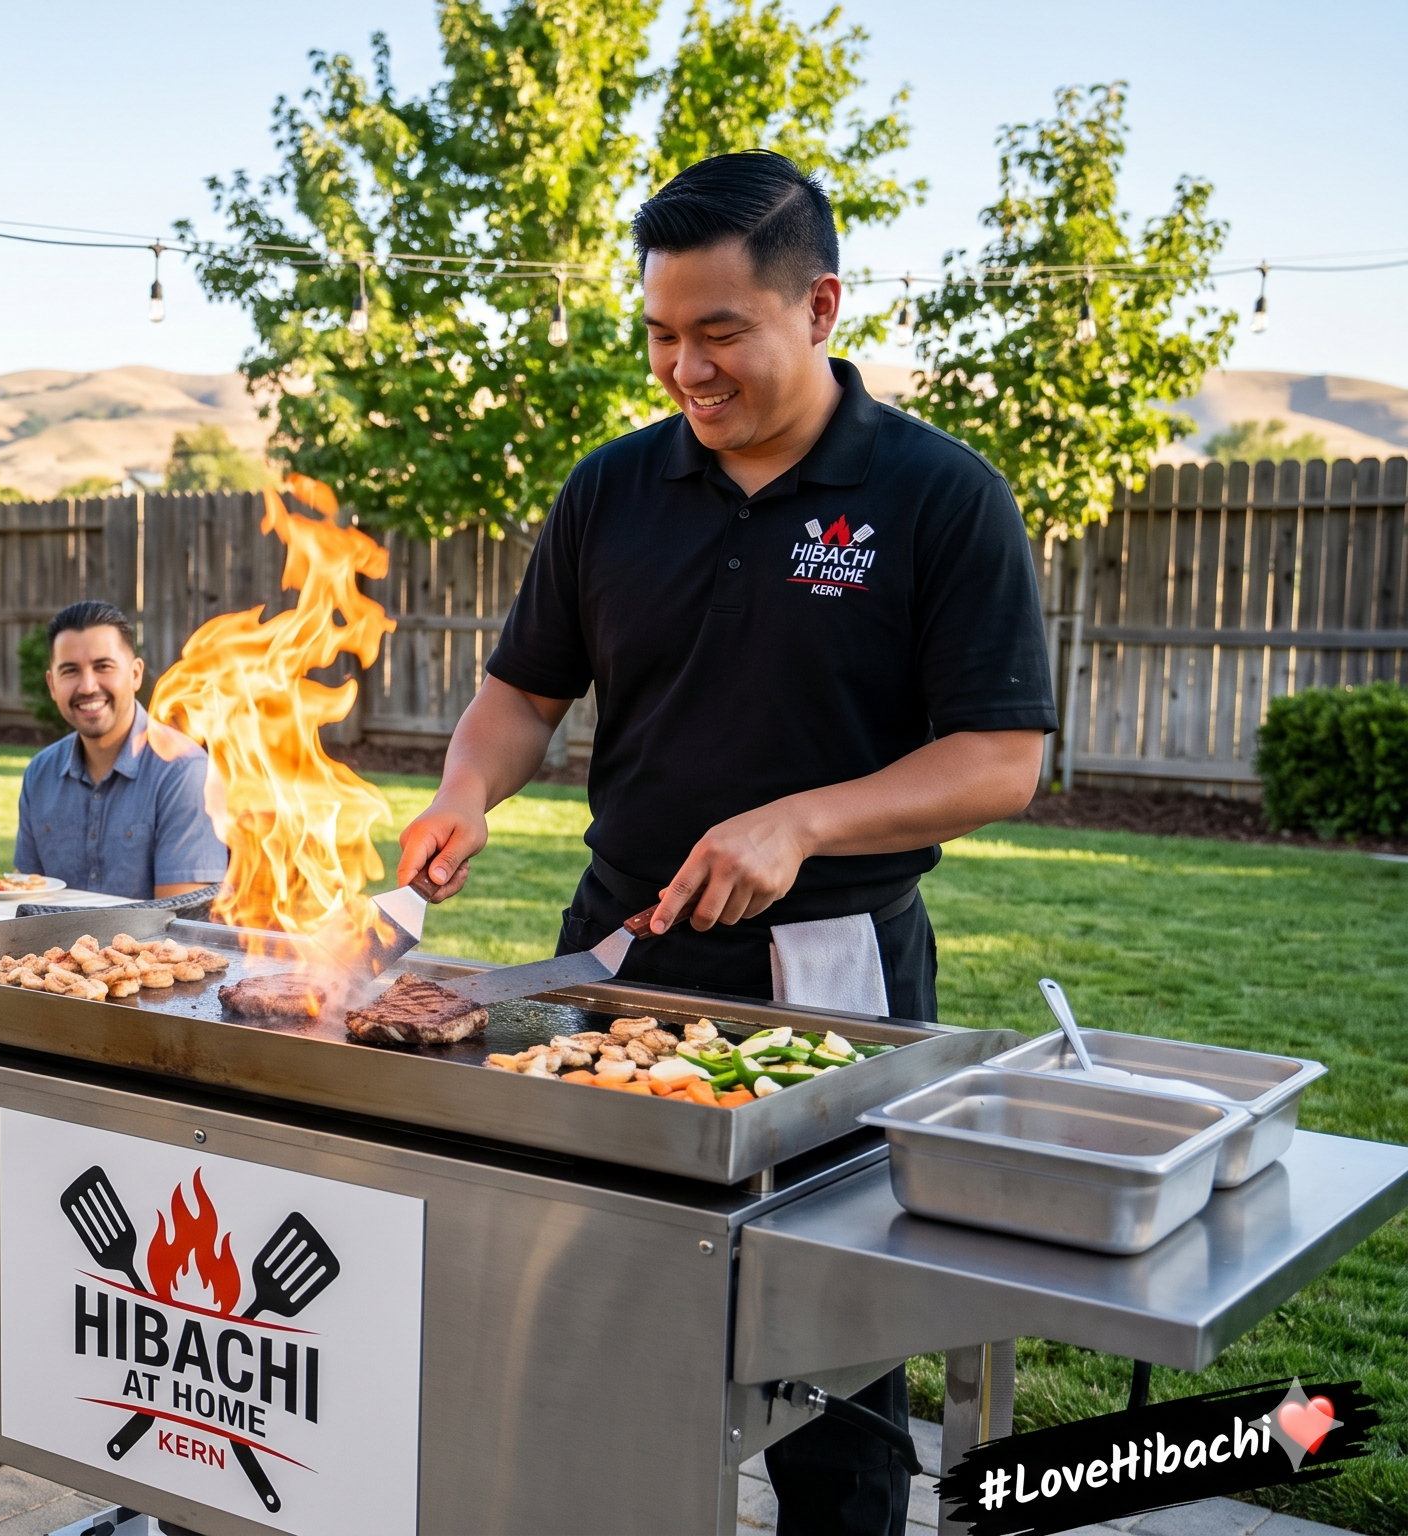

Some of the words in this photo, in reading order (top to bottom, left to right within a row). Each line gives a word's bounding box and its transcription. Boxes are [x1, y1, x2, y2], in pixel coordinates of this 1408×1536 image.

[791, 543, 875, 568] HIBACHI
[793, 563, 817, 577] AT
[820, 566, 865, 583] HOME
[811, 584, 842, 596] KERN
[75, 1283, 319, 1425] HIBACHI
[122, 1369, 161, 1402] AT
[173, 1380, 266, 1438] HOME
[158, 1430, 225, 1470] KERN
